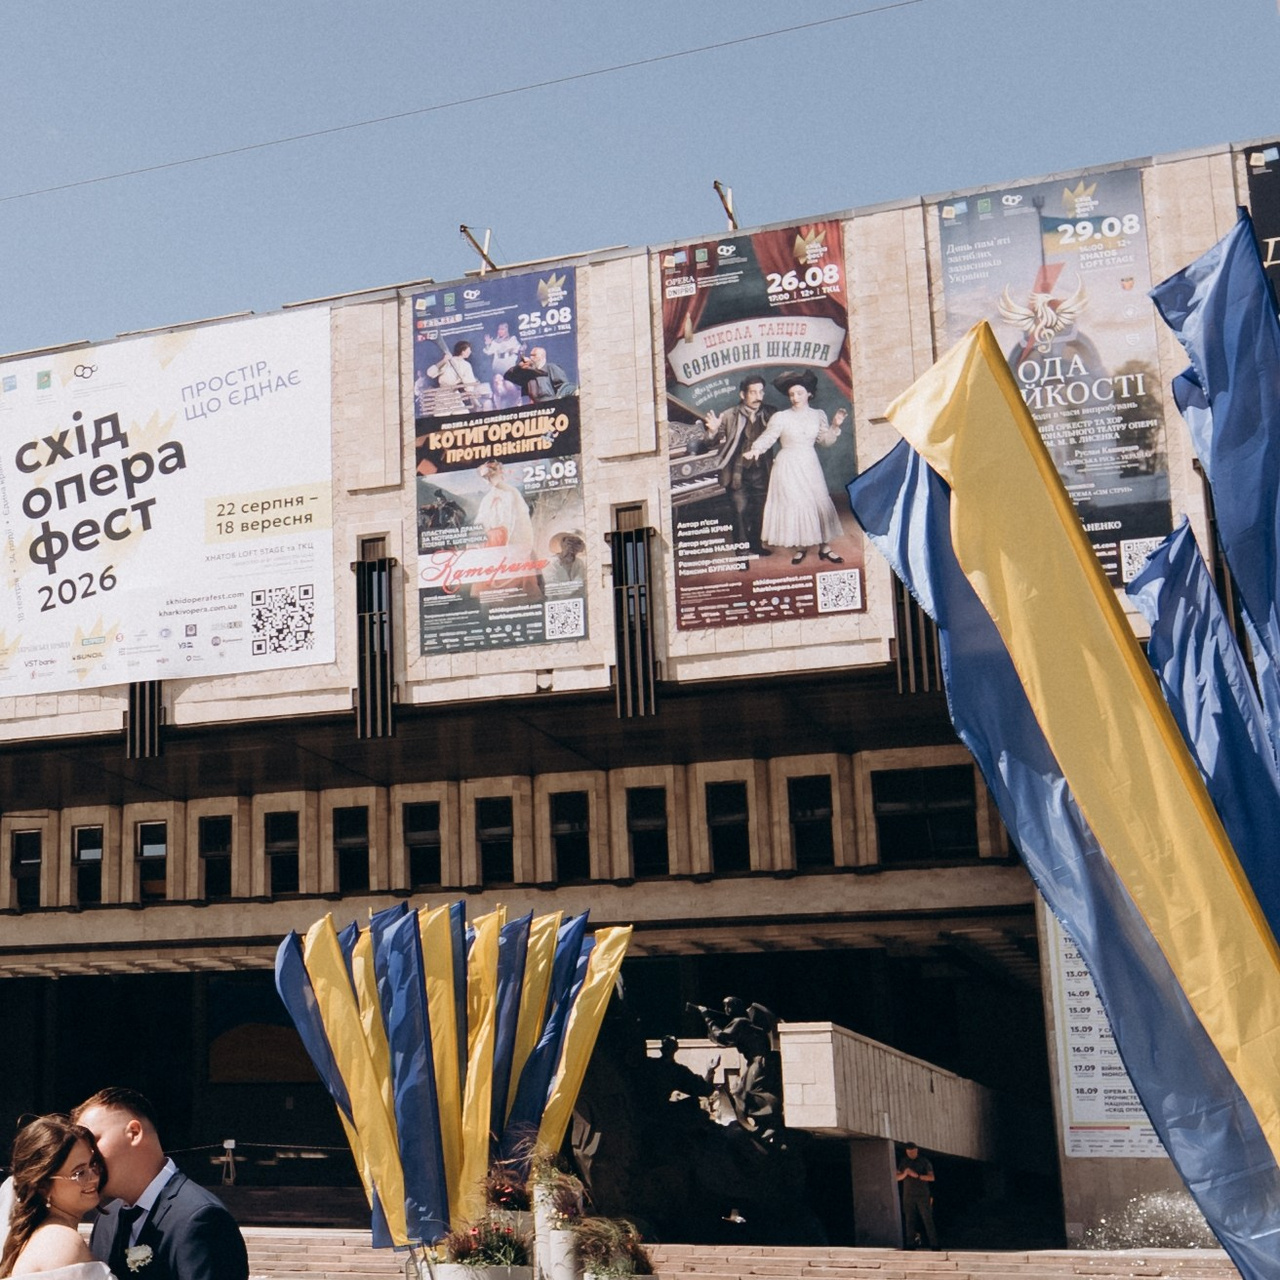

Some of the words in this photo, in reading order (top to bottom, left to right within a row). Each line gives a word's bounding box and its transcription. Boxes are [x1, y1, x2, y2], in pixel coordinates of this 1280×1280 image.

[1057, 213, 1141, 245] 29.08
[1080, 258, 1105, 269] LOFT
[1106, 254, 1135, 266] STAGE
[665, 275, 696, 287] OPERA
[766, 263, 840, 294] 26.08
[518, 307, 572, 330] 25.08
[703, 325, 752, 349] ШКОЛА
[758, 322, 808, 337] ТАНЦІВ
[682, 342, 761, 379] СОЛОМОНА
[766, 340, 831, 362] ШКЛЯРА
[1017, 354, 1089, 386] ОДА
[181, 360, 272, 402] ПРОСТІР,
[1020, 373, 1146, 409] ЙКОСТІ
[184, 397, 221, 421] ЩО
[228, 369, 302, 406] ЄДНАЄ
[1081, 402, 1138, 415] випробувань
[428, 413, 570, 451] КОТИГОРОШКО
[1056, 421, 1093, 431] ОРКЕСТР
[1093, 418, 1105, 426] ТА
[1106, 416, 1123, 424] ХОР
[1097, 424, 1127, 433] ТЕАТРУ
[1128, 419, 1158, 430] ОПЕРИ
[15, 410, 129, 474] схід
[446, 448, 492, 464] ПРОТИ
[22, 440, 187, 519] опера
[522, 460, 577, 483] 25.08
[216, 502, 236, 517] 22
[241, 495, 304, 514] серпня
[216, 521, 235, 535] 18
[240, 512, 313, 533] вересня
[461, 525, 484, 533] ДРАМА
[677, 521, 699, 530] Автор
[29, 497, 157, 575] фест
[678, 541, 699, 549] Автор
[714, 542, 750, 552] НАЗАРОВ
[238, 549, 258, 559] LOFT
[260, 546, 285, 555] STAGE
[421, 548, 551, 595] Катерина
[37, 565, 118, 613] 2026
[165, 591, 245, 606] skhidoperafest.com
[158, 603, 238, 617] kharkivopera.com.ua
[1066, 970, 1089, 978] 13.09
